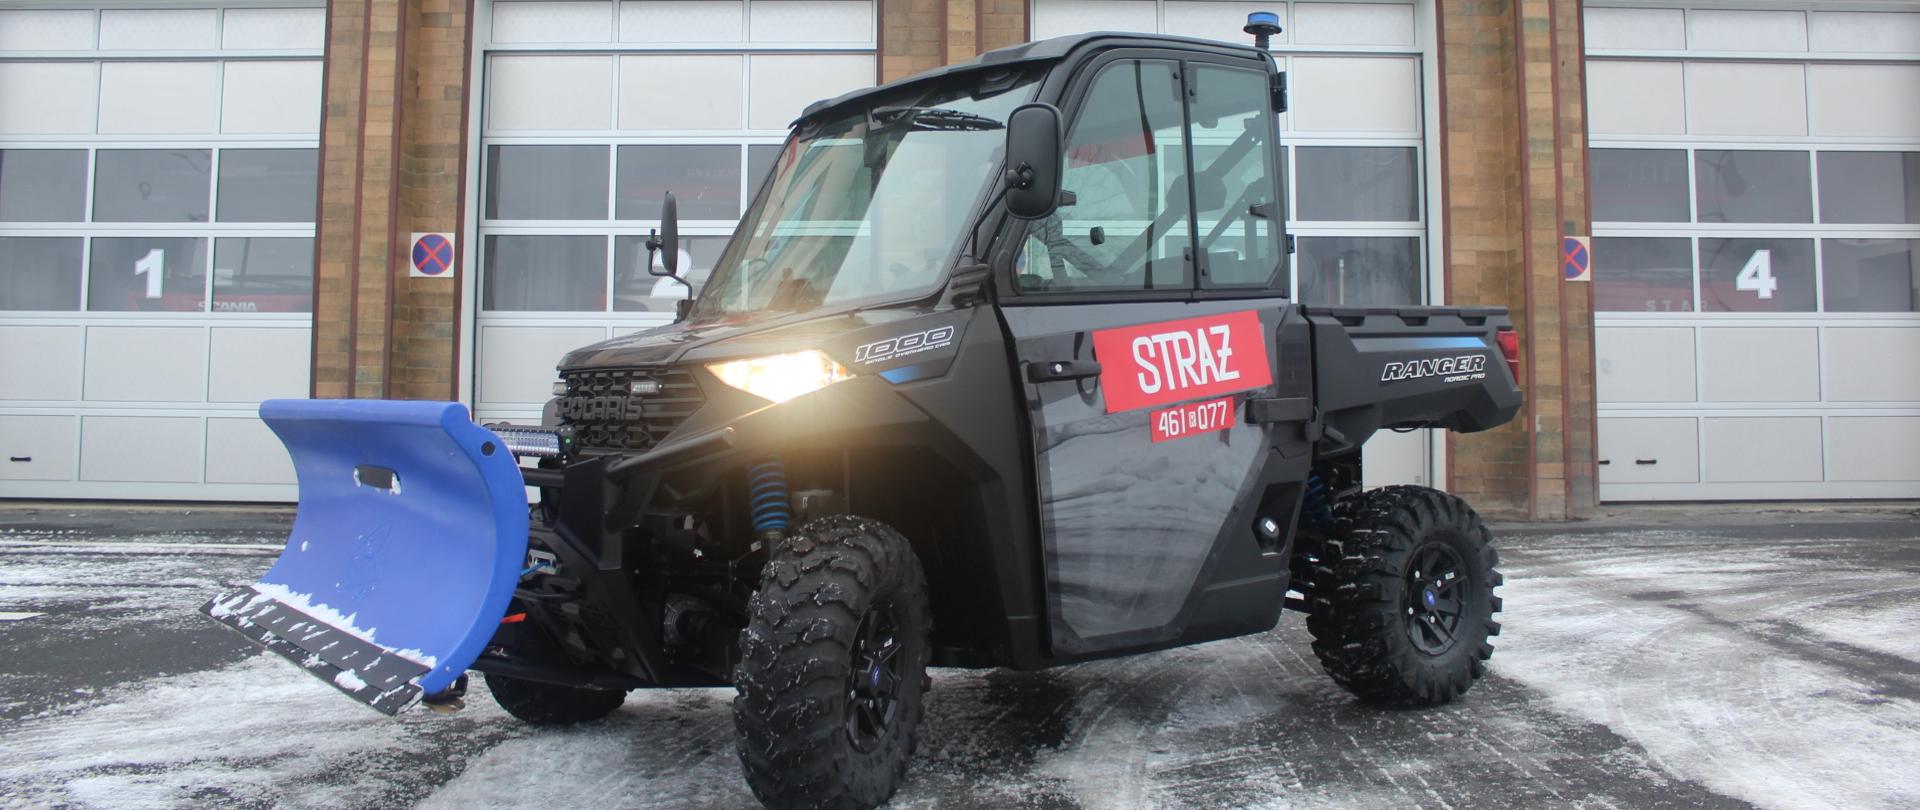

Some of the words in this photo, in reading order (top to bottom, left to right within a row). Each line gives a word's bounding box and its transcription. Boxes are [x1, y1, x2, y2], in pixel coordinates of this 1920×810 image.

[134, 248, 164, 298] 1
[649, 247, 692, 298] 2
[1736, 249, 1777, 299] 4
[855, 325, 954, 362] 1000
[1381, 355, 1486, 381] RANGER
[556, 396, 642, 420] POLARIS
